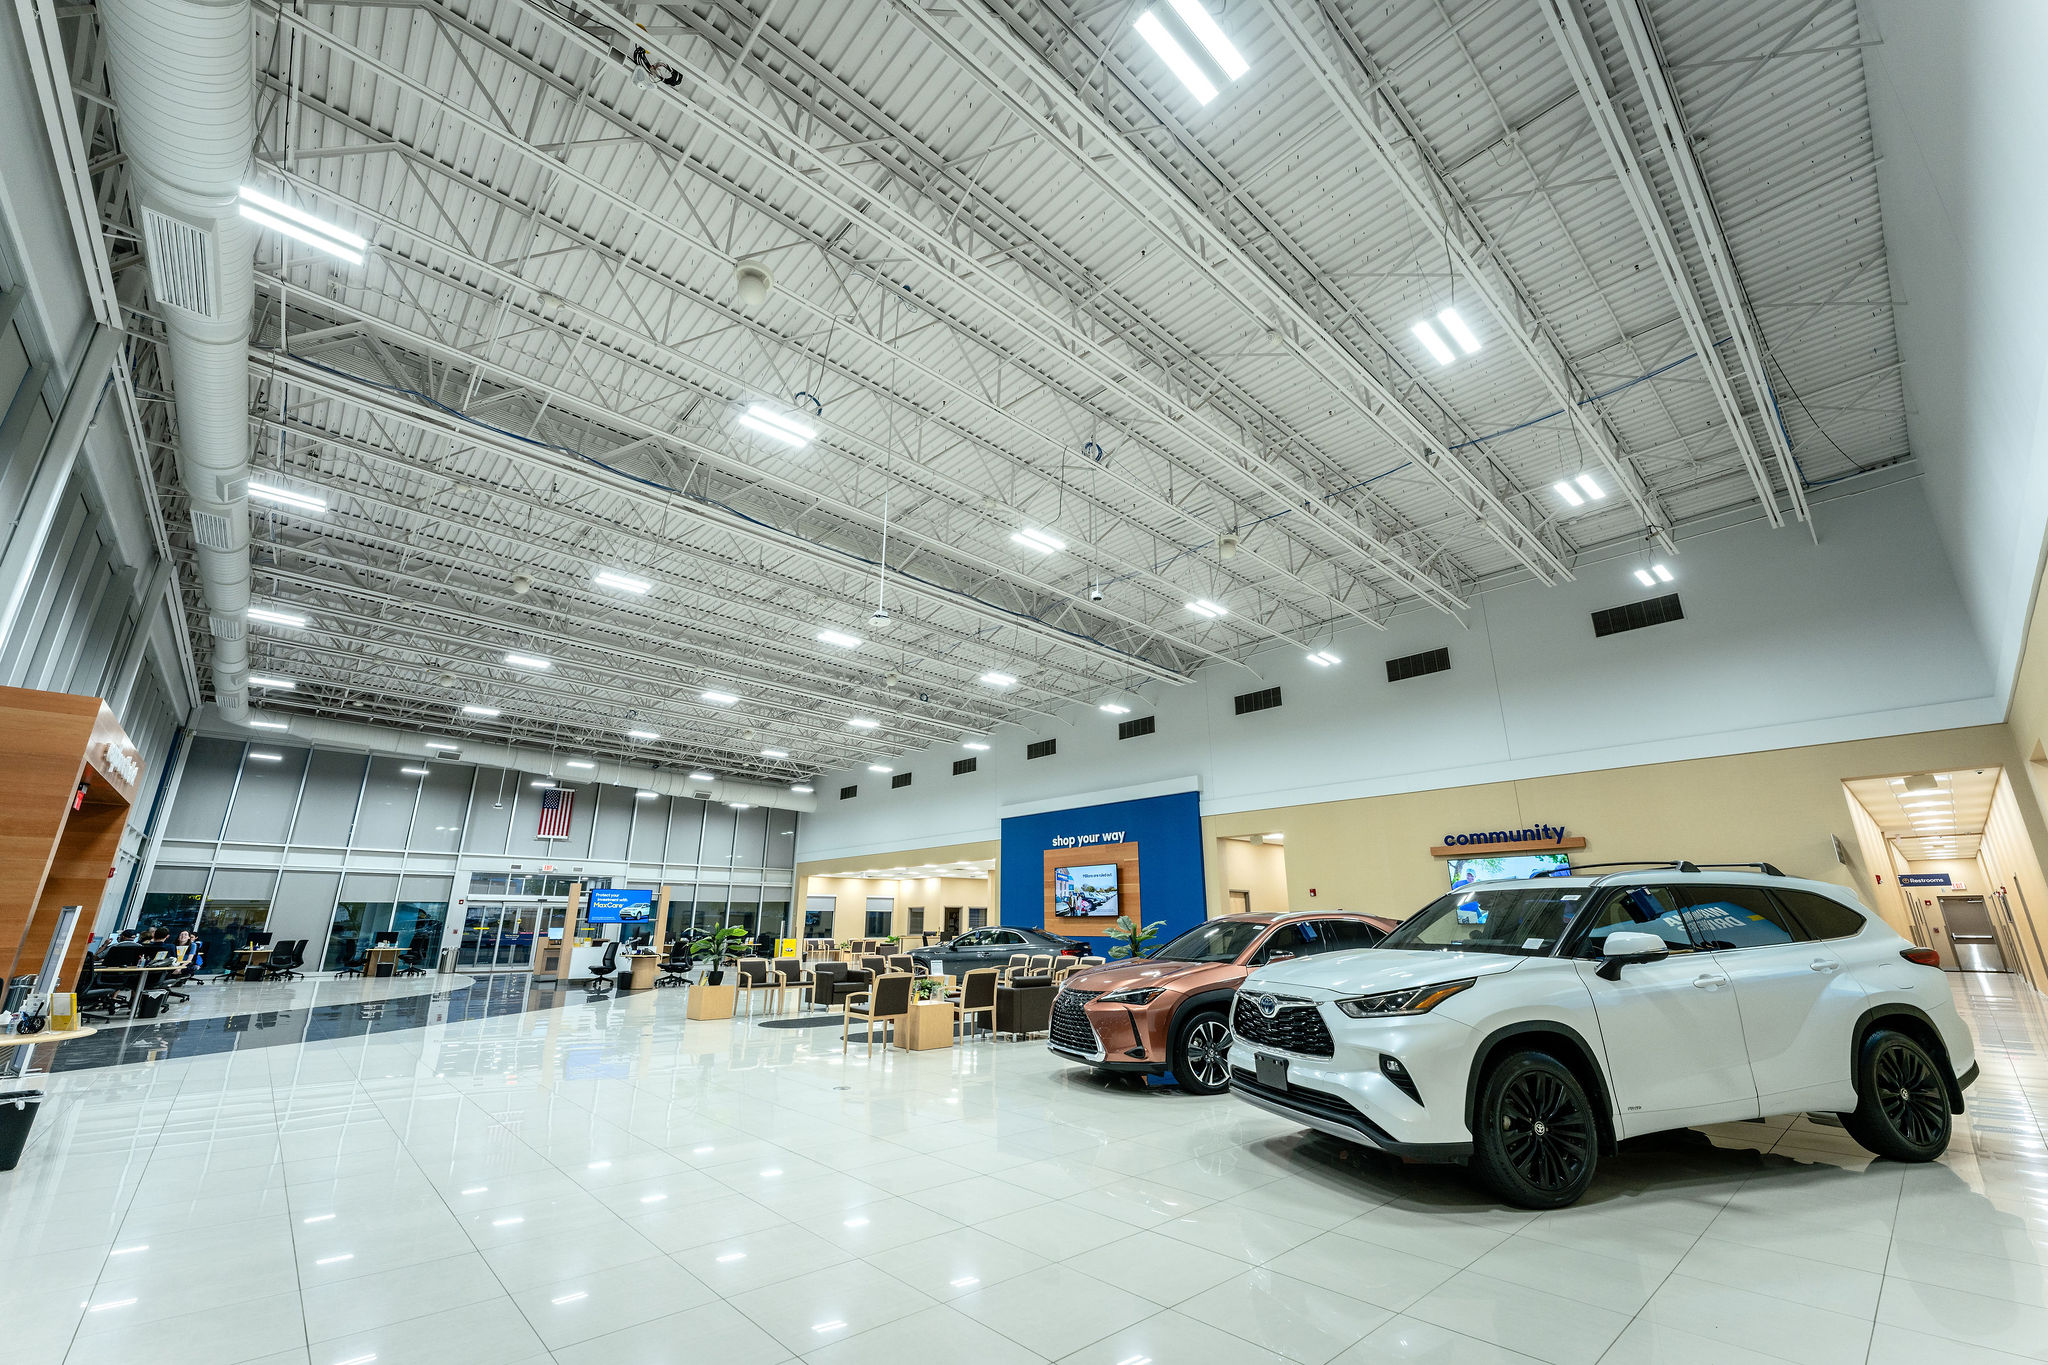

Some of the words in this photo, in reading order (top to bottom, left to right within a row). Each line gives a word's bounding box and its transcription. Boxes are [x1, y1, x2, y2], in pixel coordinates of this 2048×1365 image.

[1052, 835, 1076, 848] shop
[1078, 834, 1100, 847] your
[1102, 831, 1125, 843] way
[1444, 824, 1565, 846] community
